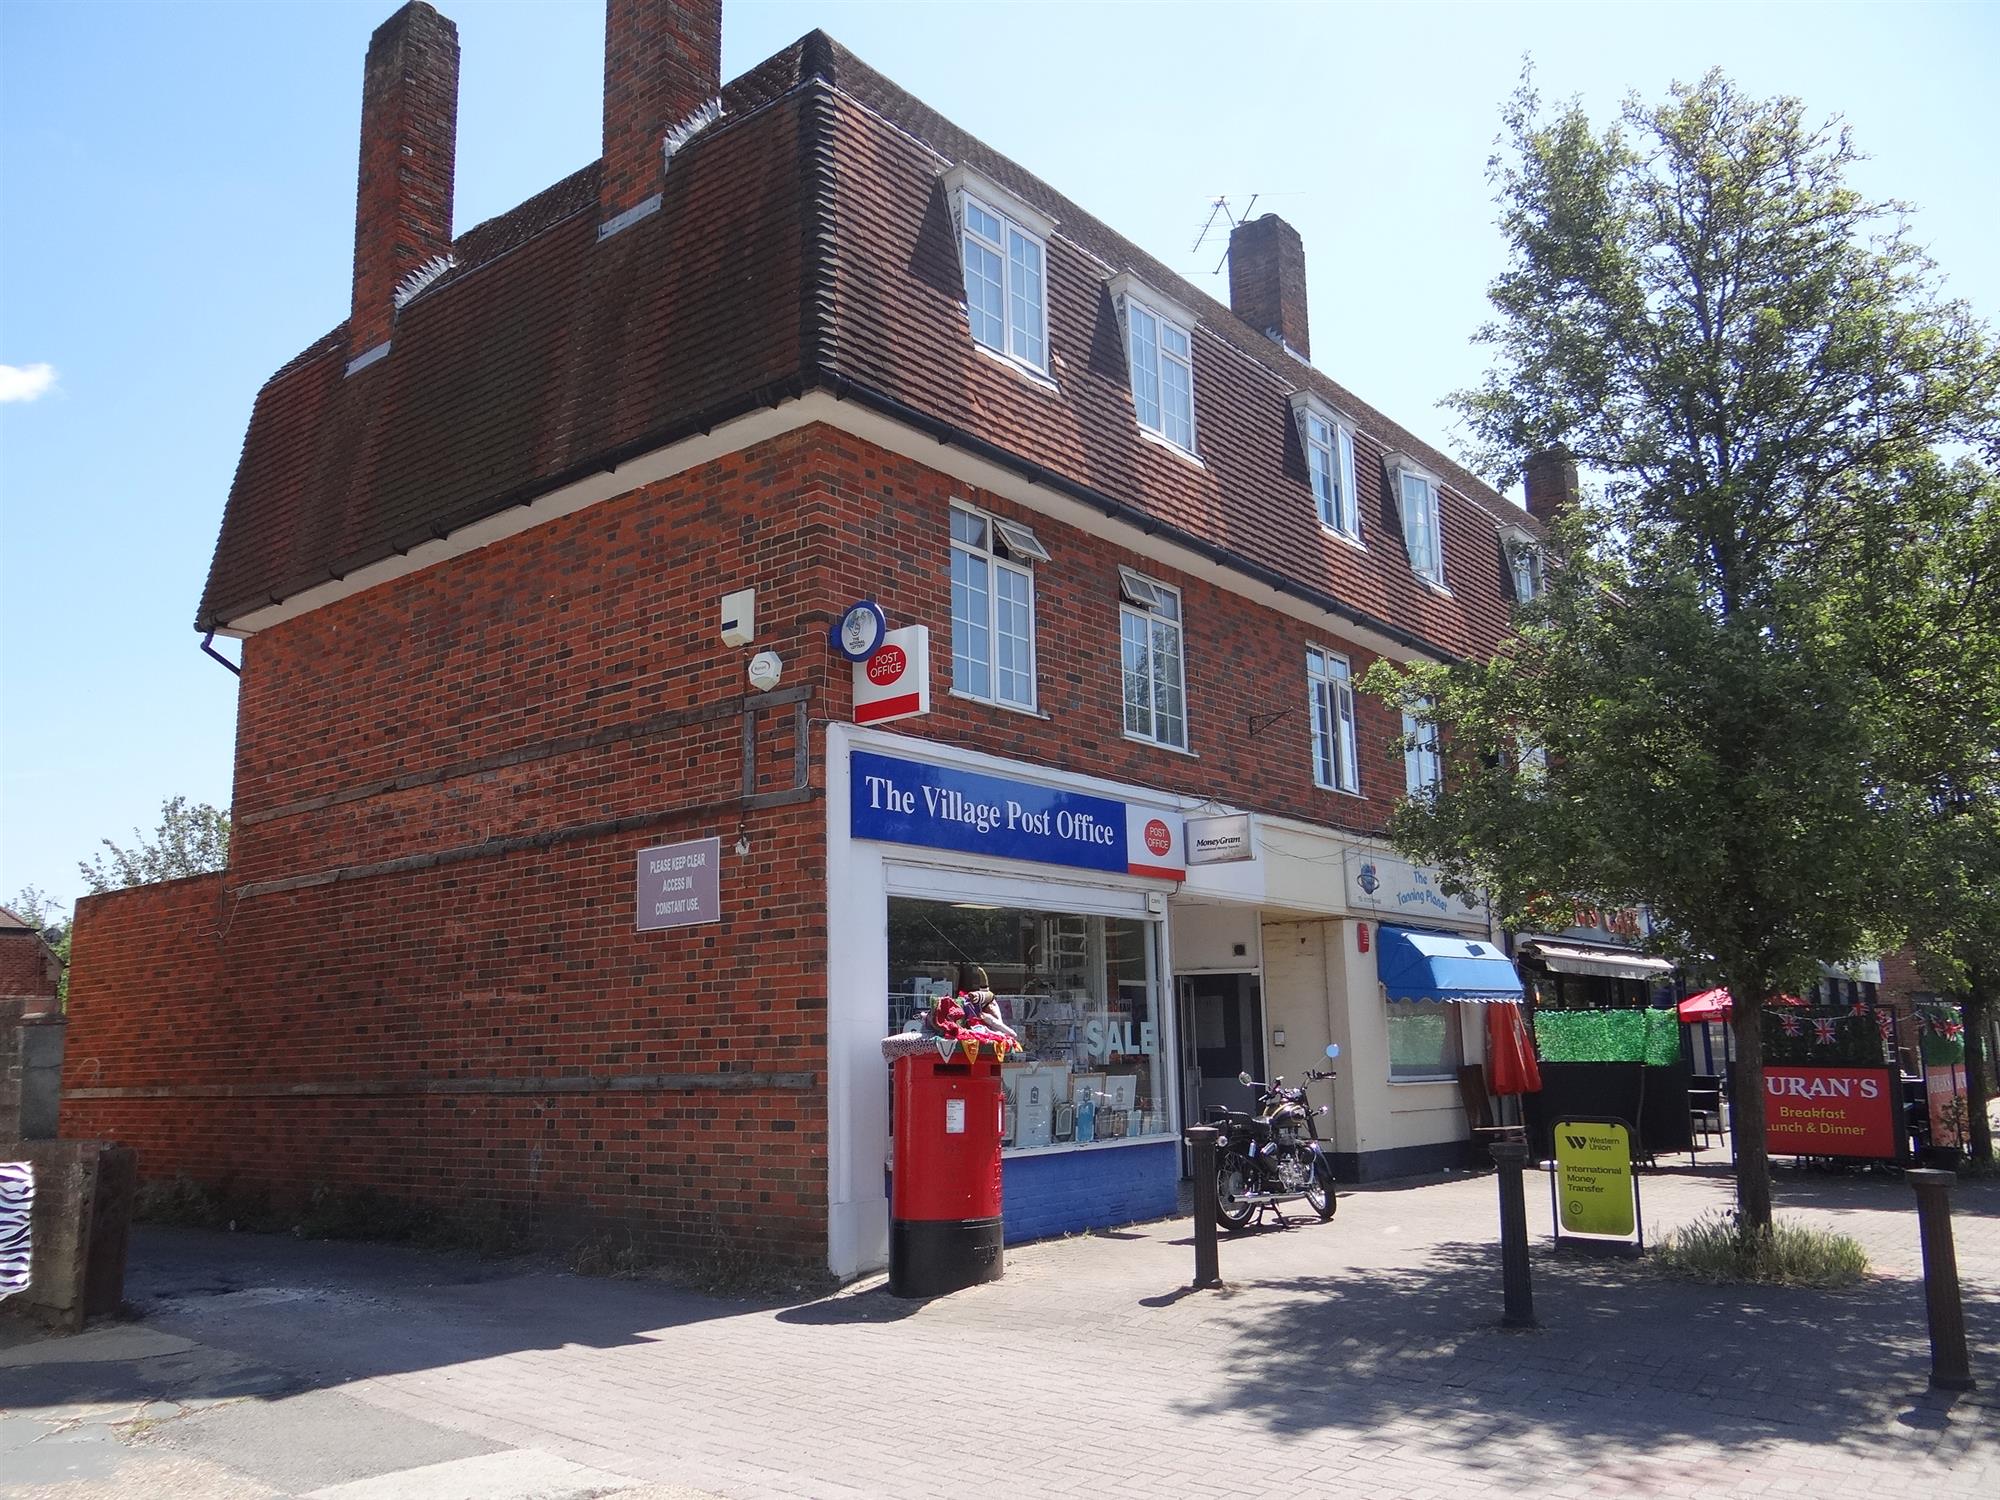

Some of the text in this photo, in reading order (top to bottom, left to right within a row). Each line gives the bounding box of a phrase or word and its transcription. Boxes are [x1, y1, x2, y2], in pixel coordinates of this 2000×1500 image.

[875, 651, 899, 666] POST
[870, 662, 902, 678] OFFICE
[865, 775, 1114, 846] The Village Post Office
[1149, 826, 1166, 837] POST
[1147, 838, 1169, 850] OFFICE
[1196, 836, 1241, 847] MoneyGram
[650, 853, 705, 873] PLEASE KEEP CLEAR
[663, 876, 693, 892] ACCESS IN
[1413, 870, 1428, 885] The
[655, 897, 699, 915] CONSTANT USE.
[1396, 887, 1425, 906] Tanning
[1426, 889, 1448, 912] Planet
[1087, 1020, 1156, 1056] SALE
[1780, 1106, 1846, 1119] Breakfast
[1766, 1121, 1866, 1135] unch & Dinner
[1588, 1137, 1620, 1145] Western
[1566, 1165, 1622, 1175] International
[1567, 1174, 1597, 1184] Money
[1568, 1183, 1604, 1193] Transfer
